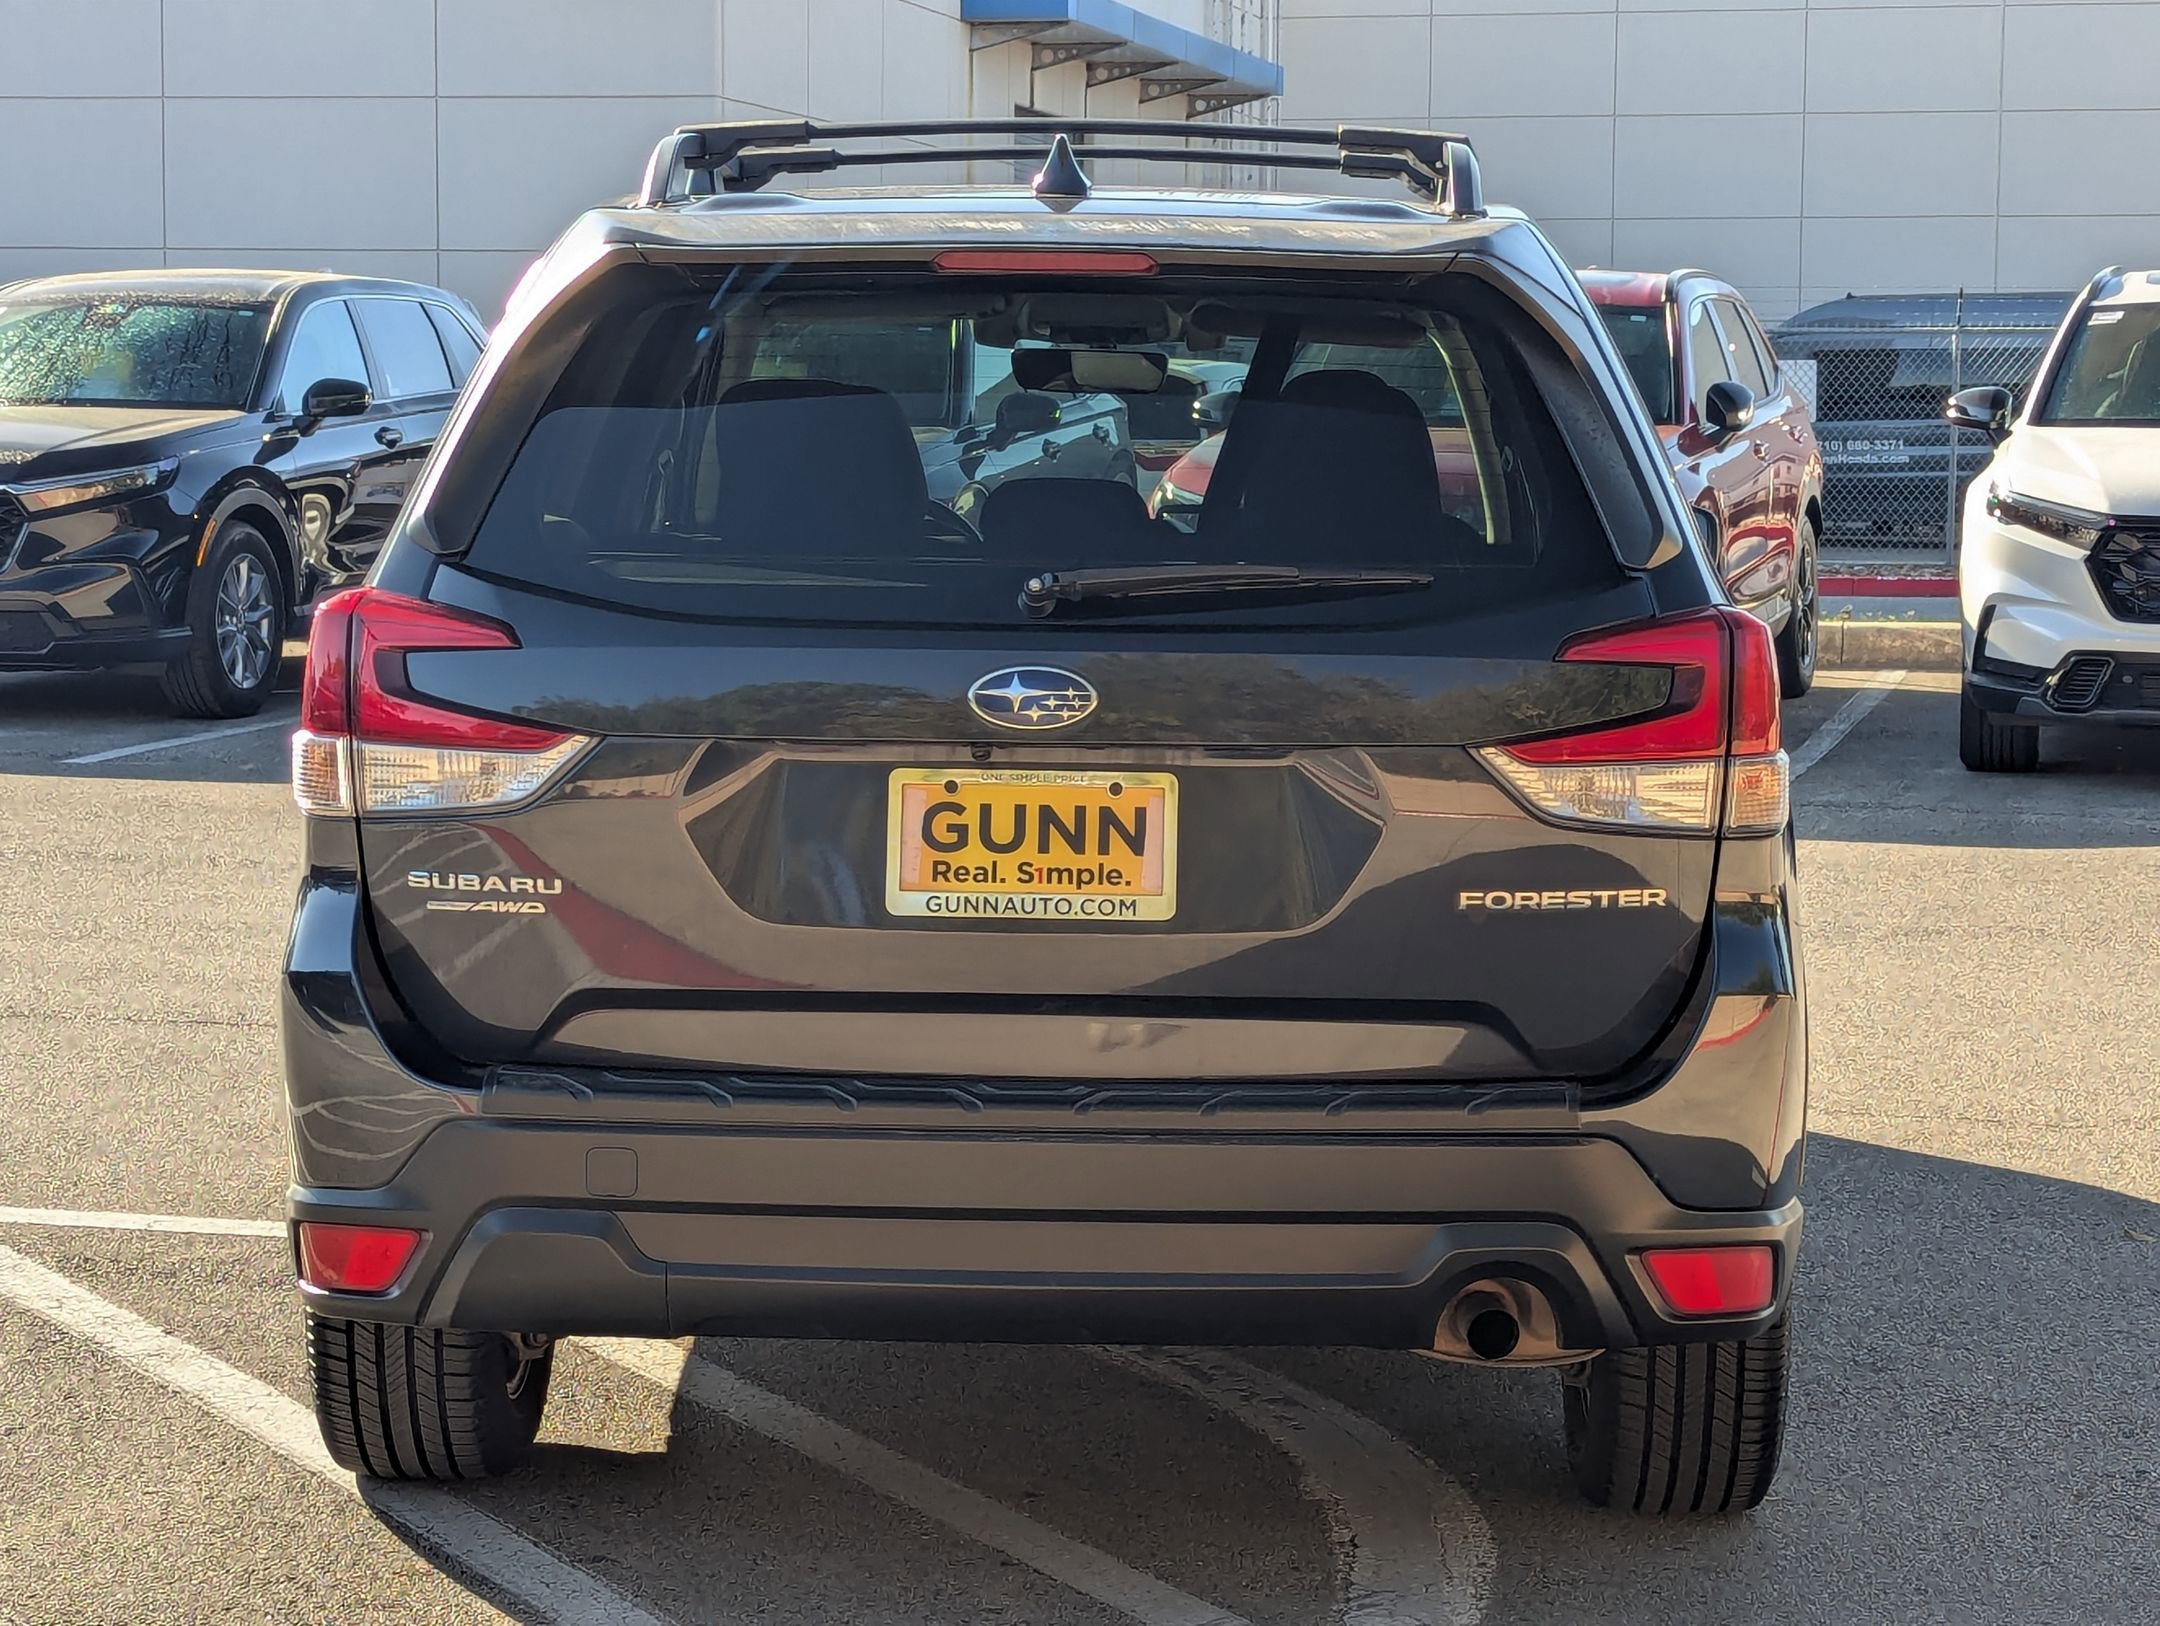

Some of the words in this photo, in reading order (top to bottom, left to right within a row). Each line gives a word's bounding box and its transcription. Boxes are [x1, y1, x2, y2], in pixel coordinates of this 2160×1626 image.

[1822, 454, 1910, 464] nnHonda.com
[921, 801, 1147, 857] GUNN
[407, 870, 562, 895] SUBARU
[931, 860, 1007, 884] Real.
[470, 901, 546, 914] AWD
[925, 895, 1137, 917] GUNNAUTO.COM
[1458, 889, 1667, 910] FORESTER
